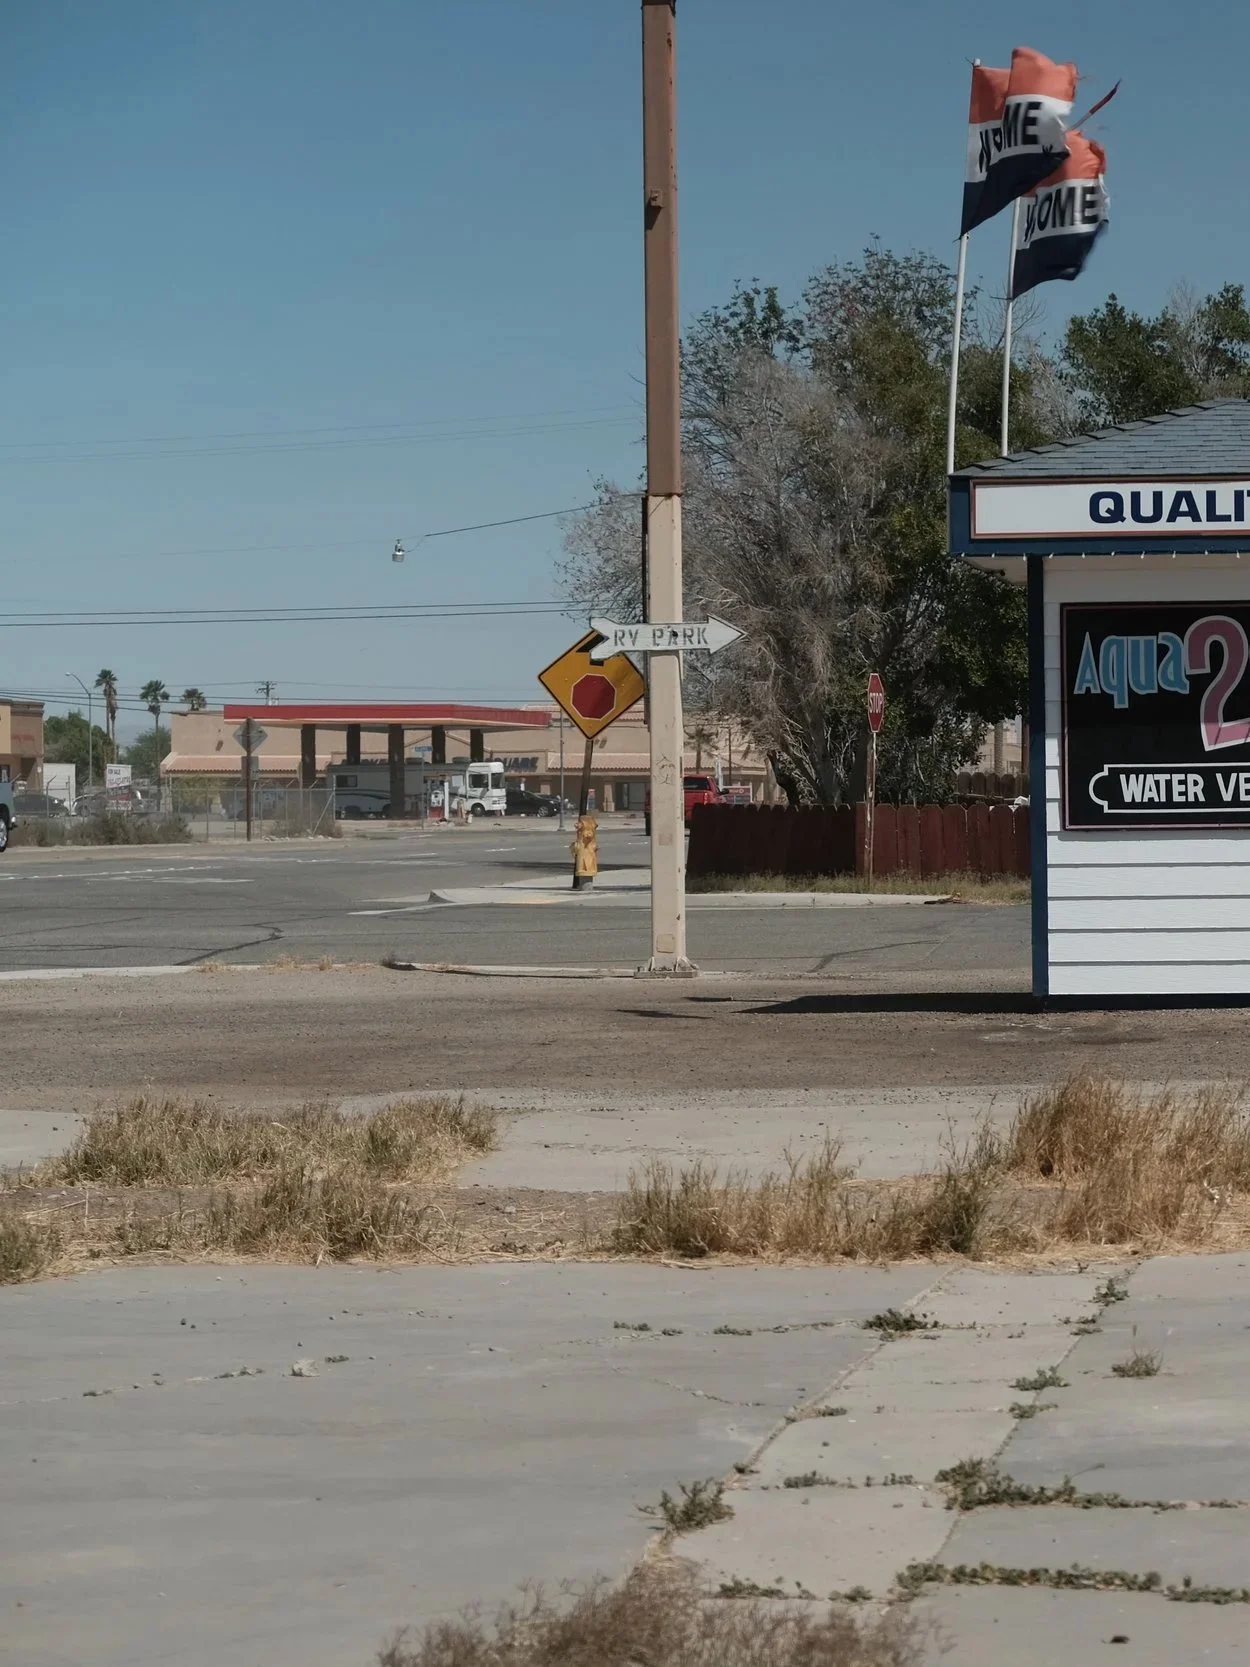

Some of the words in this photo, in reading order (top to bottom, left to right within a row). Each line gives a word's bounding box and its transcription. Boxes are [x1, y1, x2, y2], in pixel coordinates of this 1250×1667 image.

[613, 629, 639, 647] RV
[652, 627, 709, 647] PARK
[870, 692, 883, 713] STOP
[1119, 773, 1206, 803] WATER
